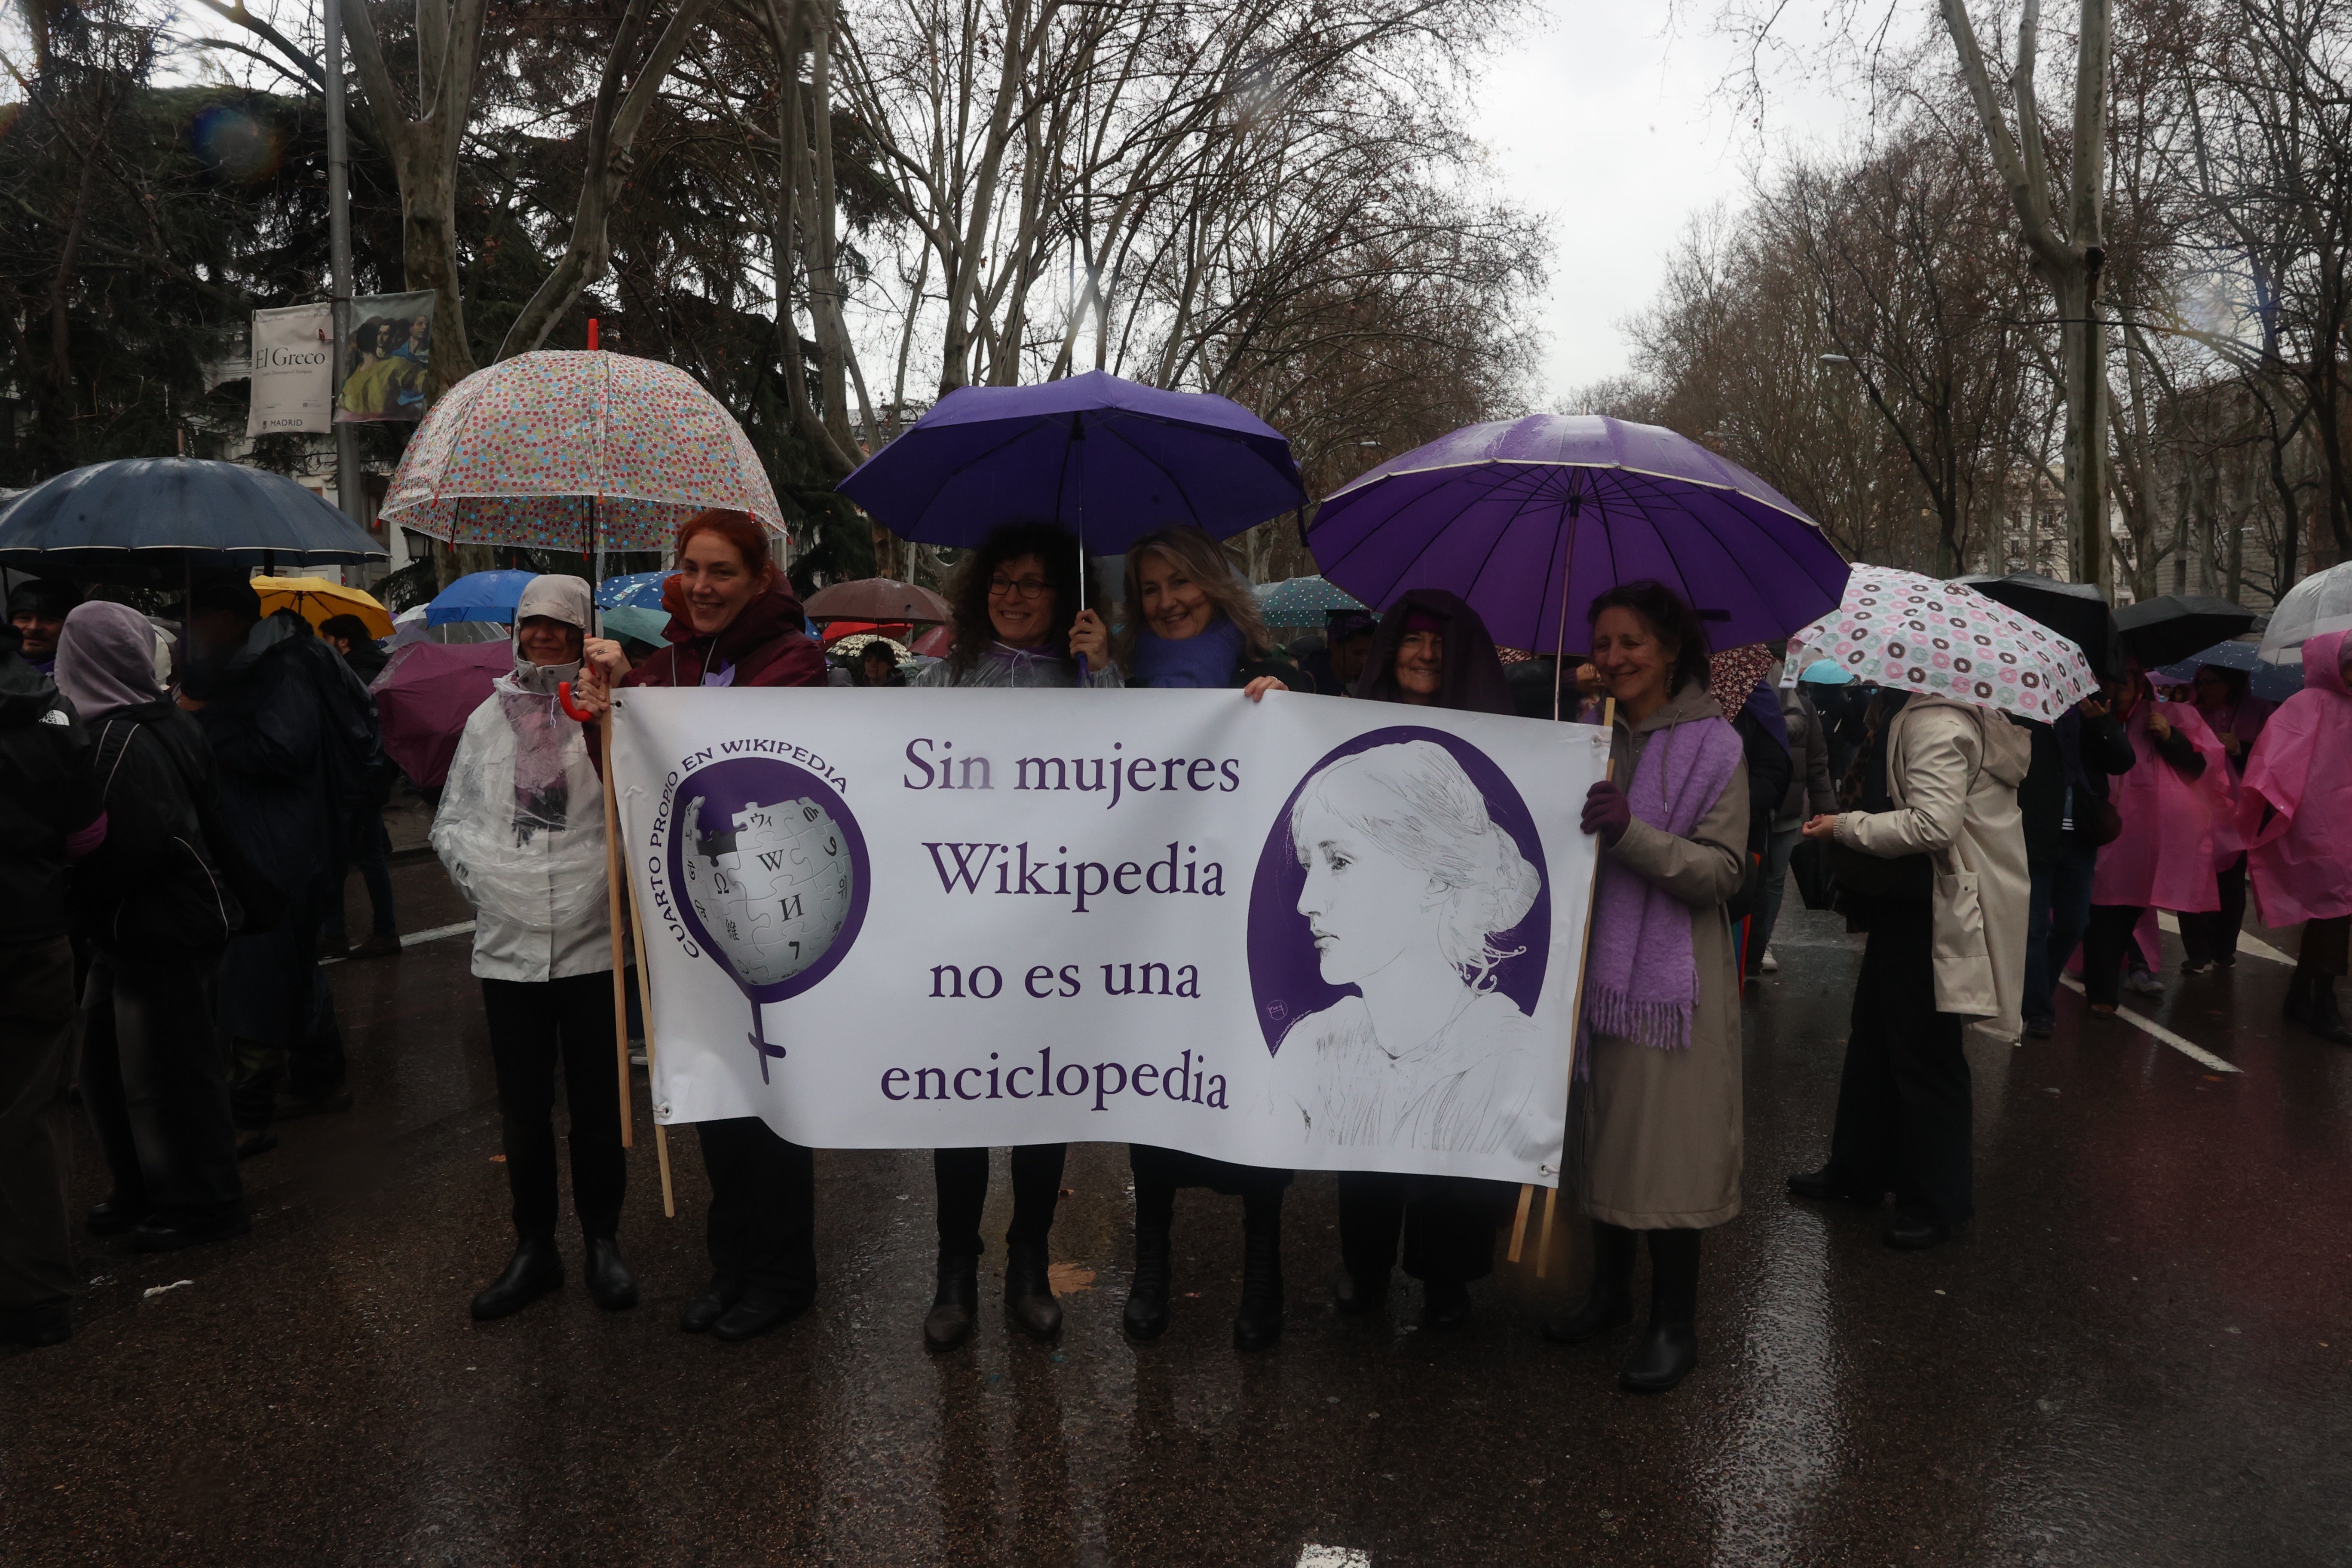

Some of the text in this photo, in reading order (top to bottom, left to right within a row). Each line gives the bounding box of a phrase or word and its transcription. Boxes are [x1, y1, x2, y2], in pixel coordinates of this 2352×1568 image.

[256, 347, 325, 369] El Greco
[904, 738, 1239, 810] Sin mujeres
[649, 739, 846, 958] CUARTO PROPIO EN WIKIPEDIA
[756, 849, 784, 872] W
[921, 841, 1225, 913] Wikipedia
[778, 893, 805, 922] И
[928, 962, 1201, 998] no es una
[881, 1046, 1229, 1112] enciclopedia
